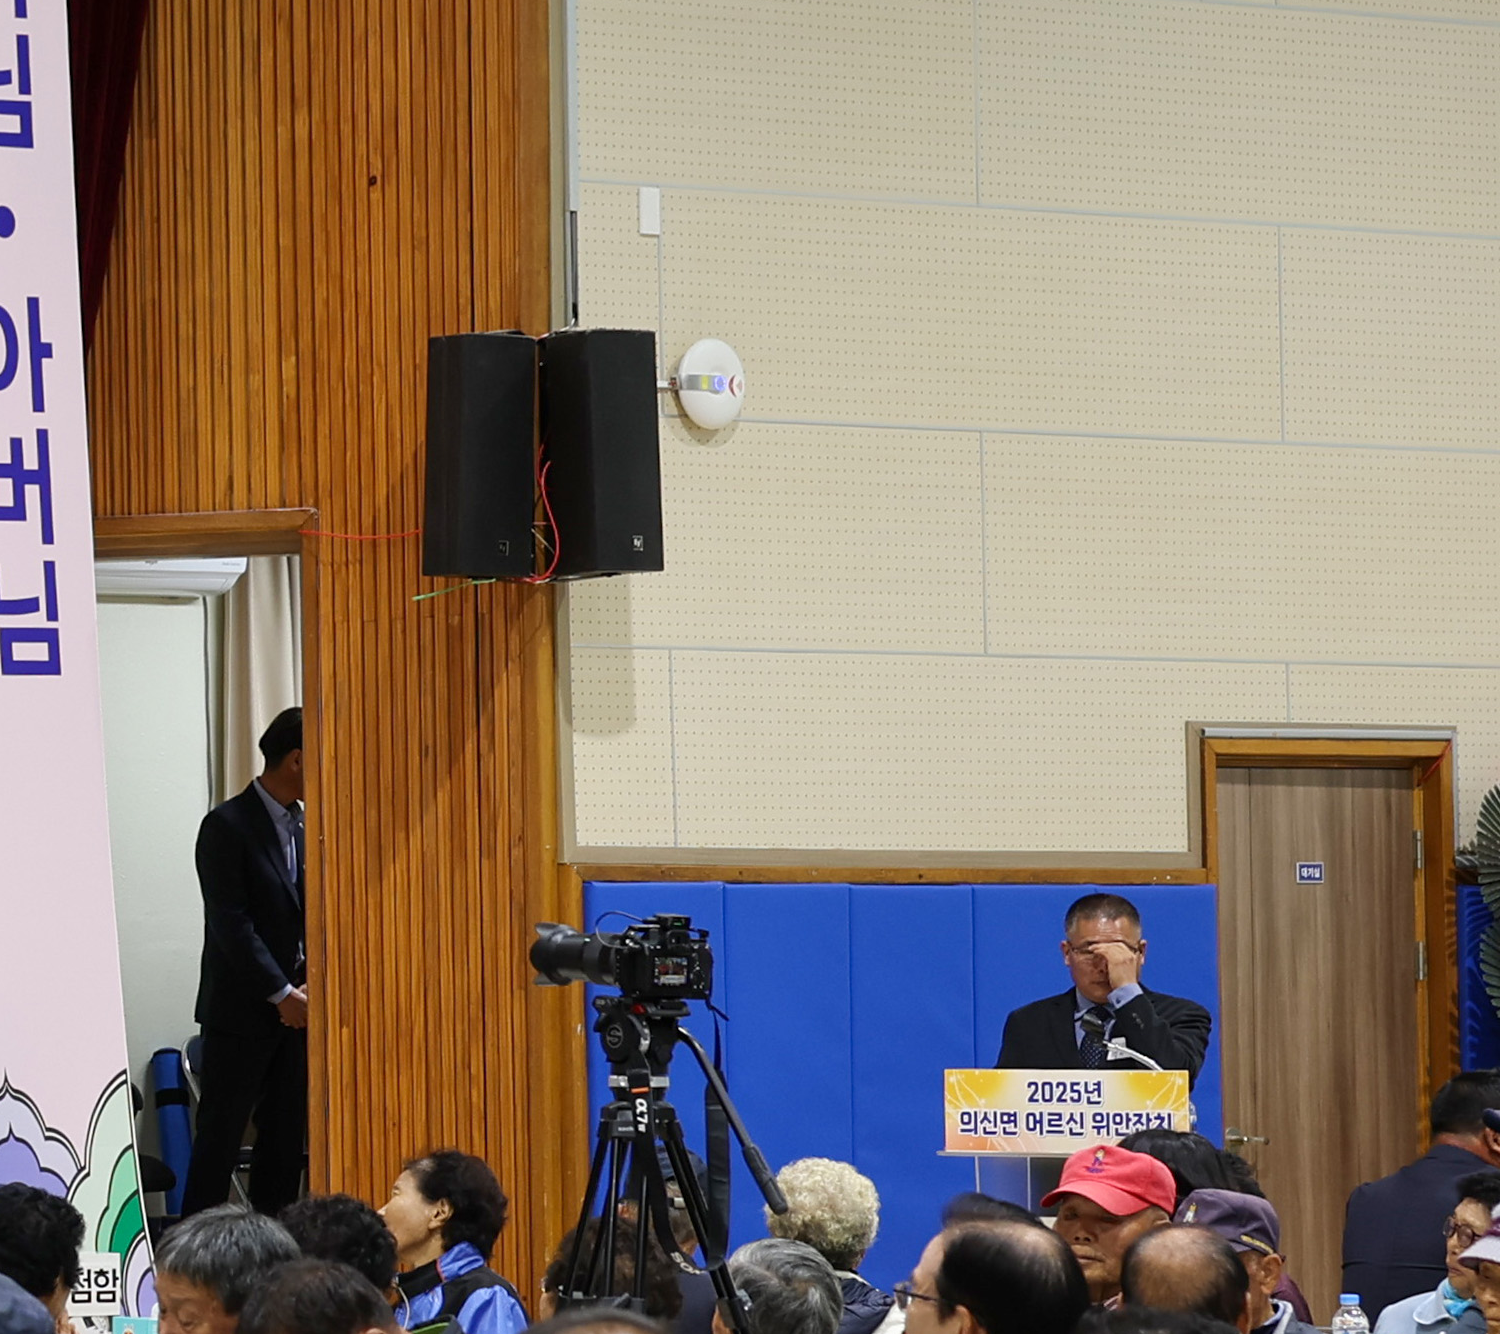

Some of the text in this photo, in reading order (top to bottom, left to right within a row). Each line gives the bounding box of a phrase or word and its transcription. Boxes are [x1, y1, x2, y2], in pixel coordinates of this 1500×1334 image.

[1026, 1080, 1103, 1105] 2025년
[959, 1110, 1019, 1136] 의신면
[1025, 1110, 1085, 1136] 어르신
